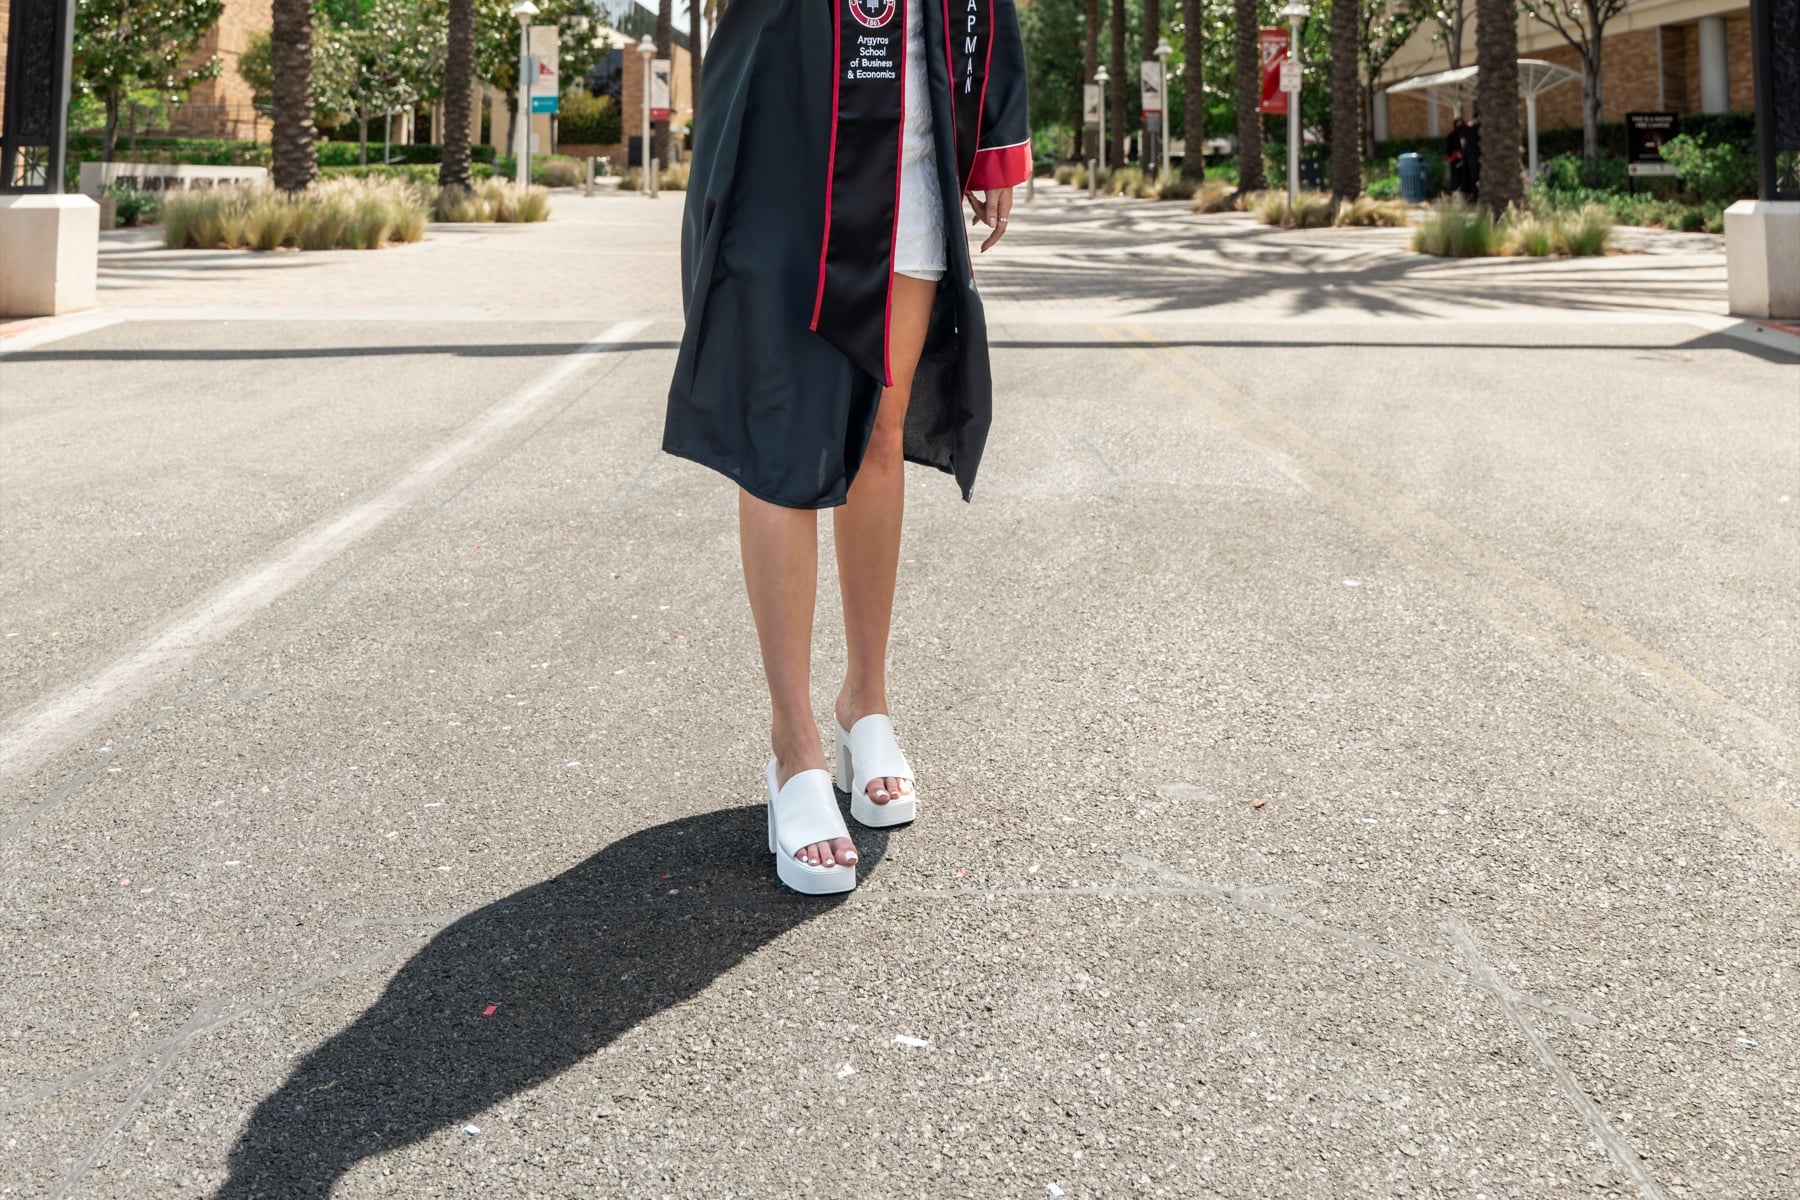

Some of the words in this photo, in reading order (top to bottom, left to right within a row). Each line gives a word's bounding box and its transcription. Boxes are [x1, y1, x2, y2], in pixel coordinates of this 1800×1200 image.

[857, 35, 889, 46] Argyros
[859, 46, 887, 56] School
[850, 57, 860, 68] of
[861, 58, 893, 67] Business
[847, 70, 854, 79] &
[856, 70, 896, 79] Economics
